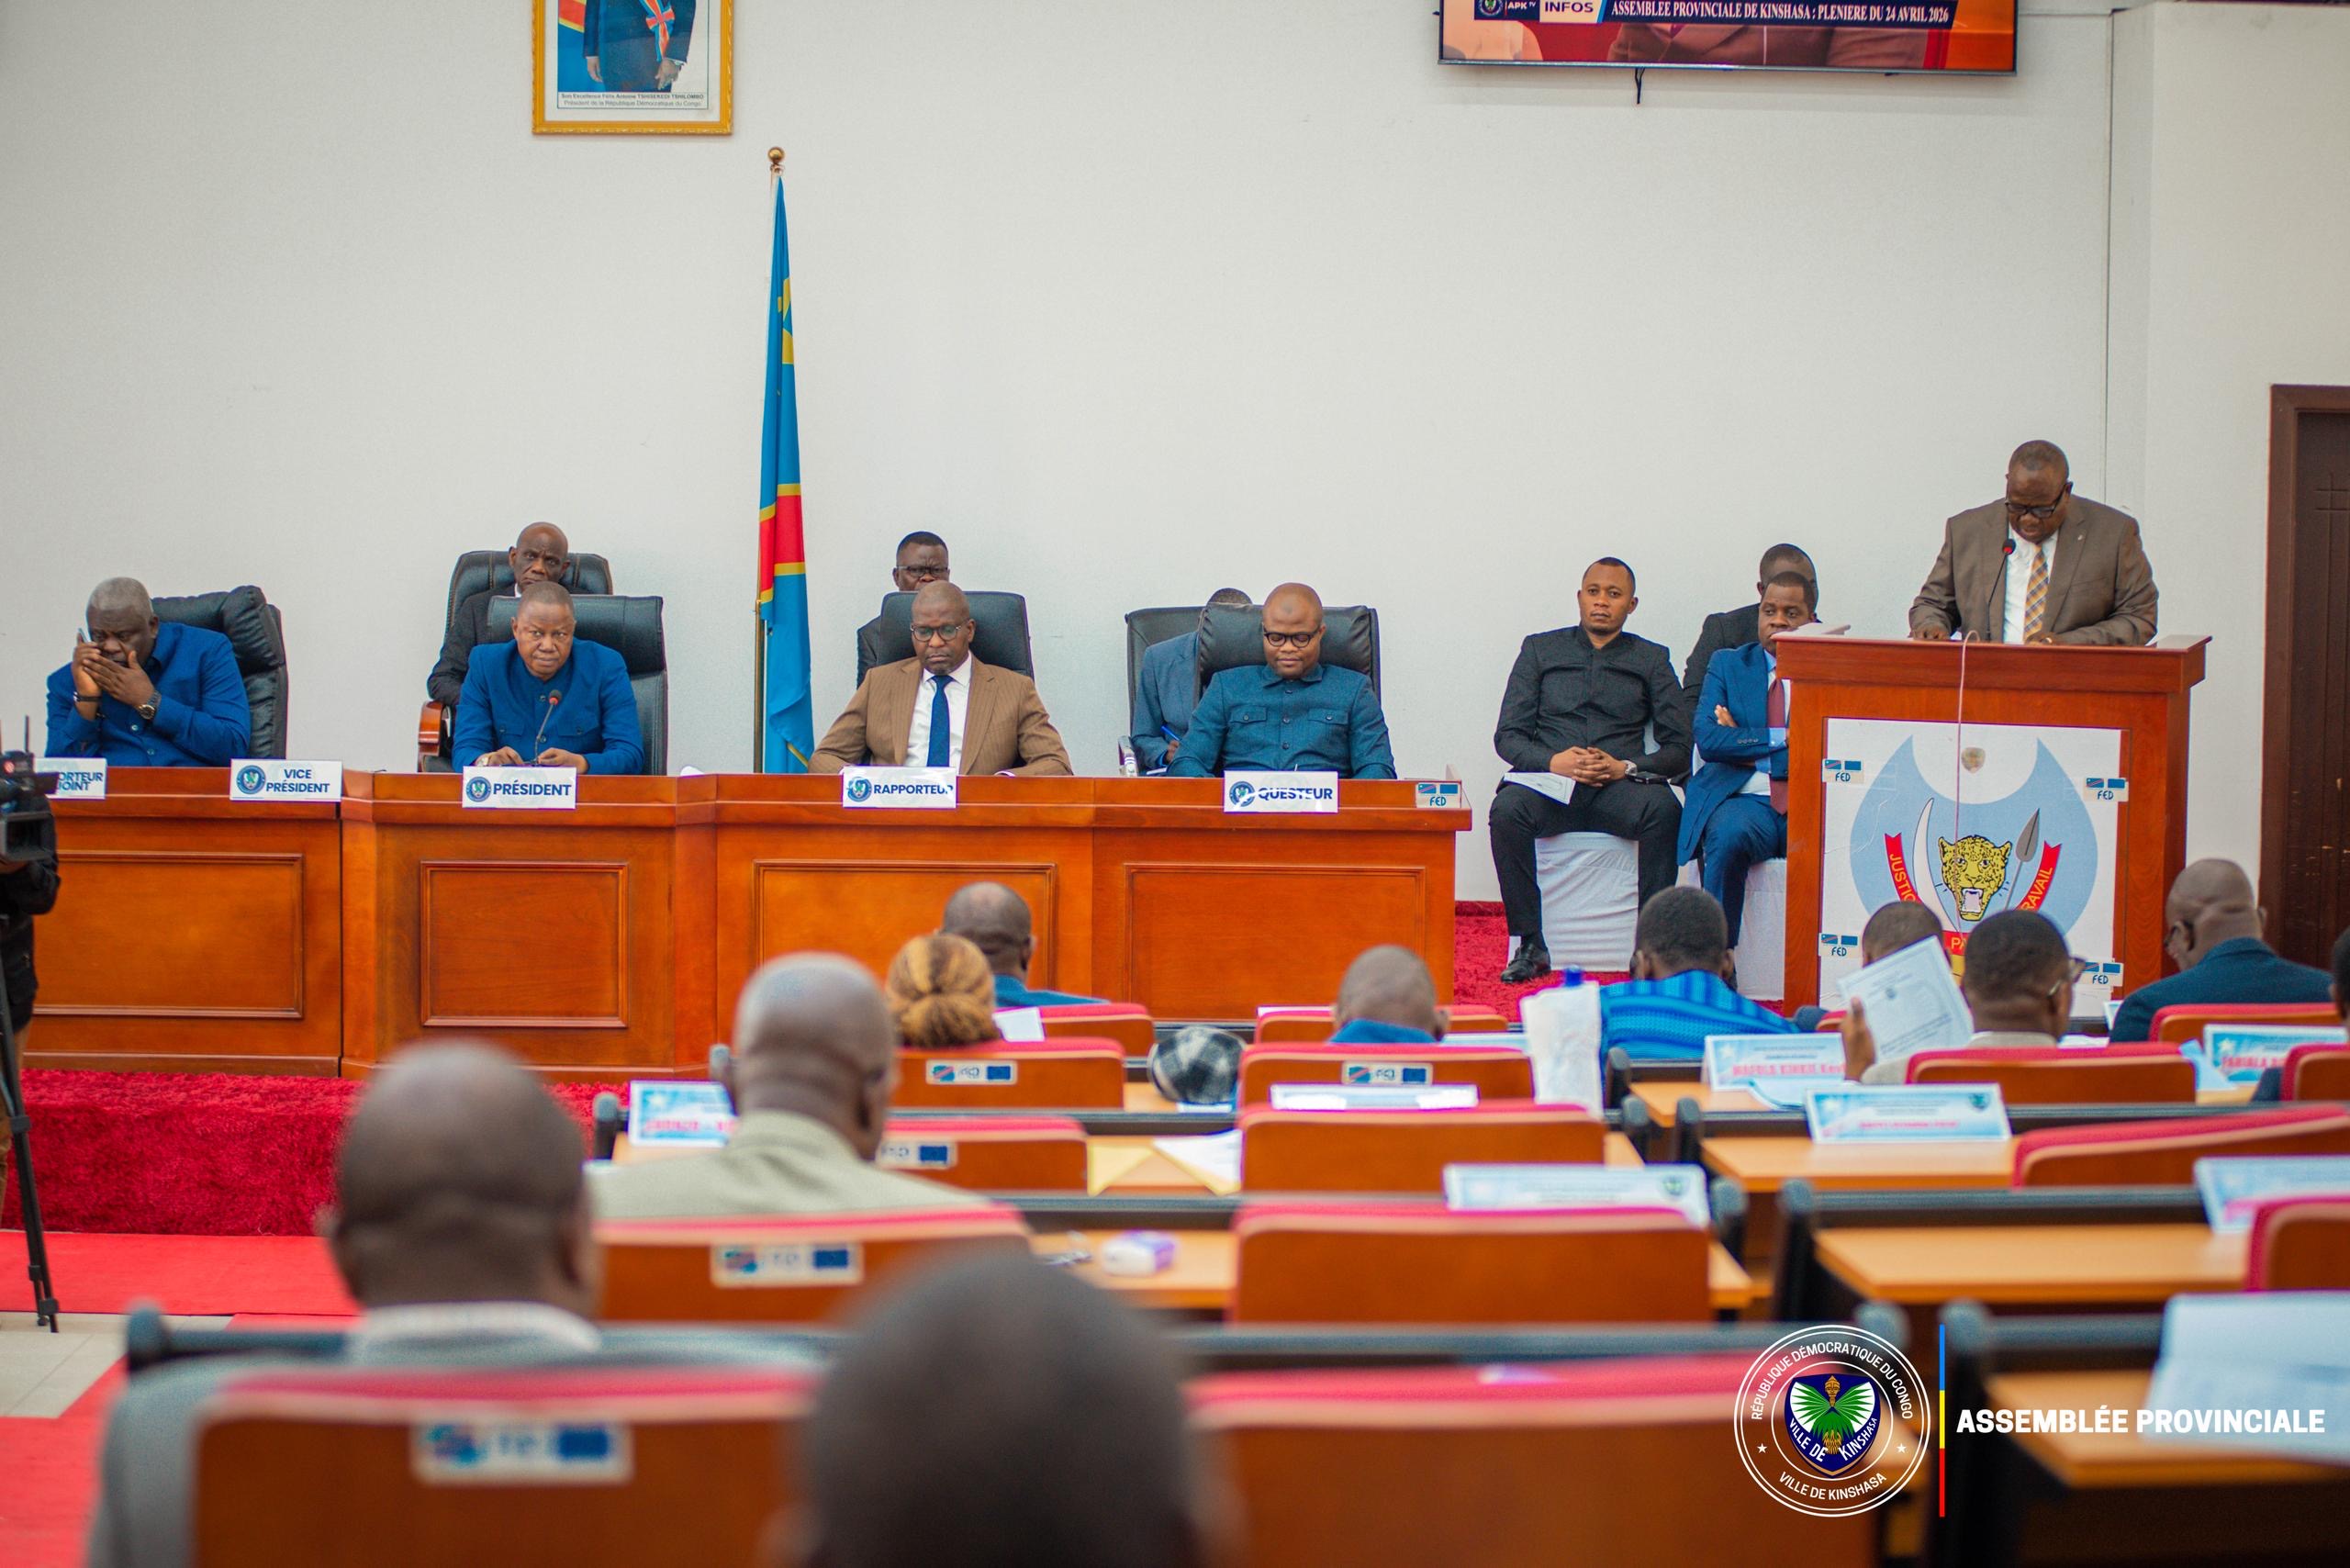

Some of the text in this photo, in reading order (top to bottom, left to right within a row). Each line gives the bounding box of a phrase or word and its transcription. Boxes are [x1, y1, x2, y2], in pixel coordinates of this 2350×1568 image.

[1507, 1, 1528, 10] APK
[1544, 1, 1594, 13] INFOS
[1611, 0, 1672, 17] ASSEMBLEE
[1673, 1, 1742, 18] PROVINCIALE
[1744, 3, 1758, 18] DE
[1760, 3, 1811, 19] KINSHASA
[1818, 5, 1867, 20] PLENIERE
[1869, 6, 1884, 21] DU
[1885, 6, 1896, 21] 24
[1897, 6, 1928, 22] AVRIL
[1928, 7, 1950, 23] 2026
[59, 771, 104, 782] ORTEUR
[284, 768, 312, 779] VICE
[1836, 772, 1851, 782] FED
[266, 779, 330, 793] PRÉSIDENT
[493, 779, 572, 796] PRÉSIDENT
[2097, 790, 2114, 801] FED
[1429, 796, 1447, 807] FED
[1889, 854, 1917, 902] JUSTIC
[2021, 867, 2053, 911] RAVAIL
[1831, 946, 1847, 957] FED
[2092, 974, 2109, 985] FED
